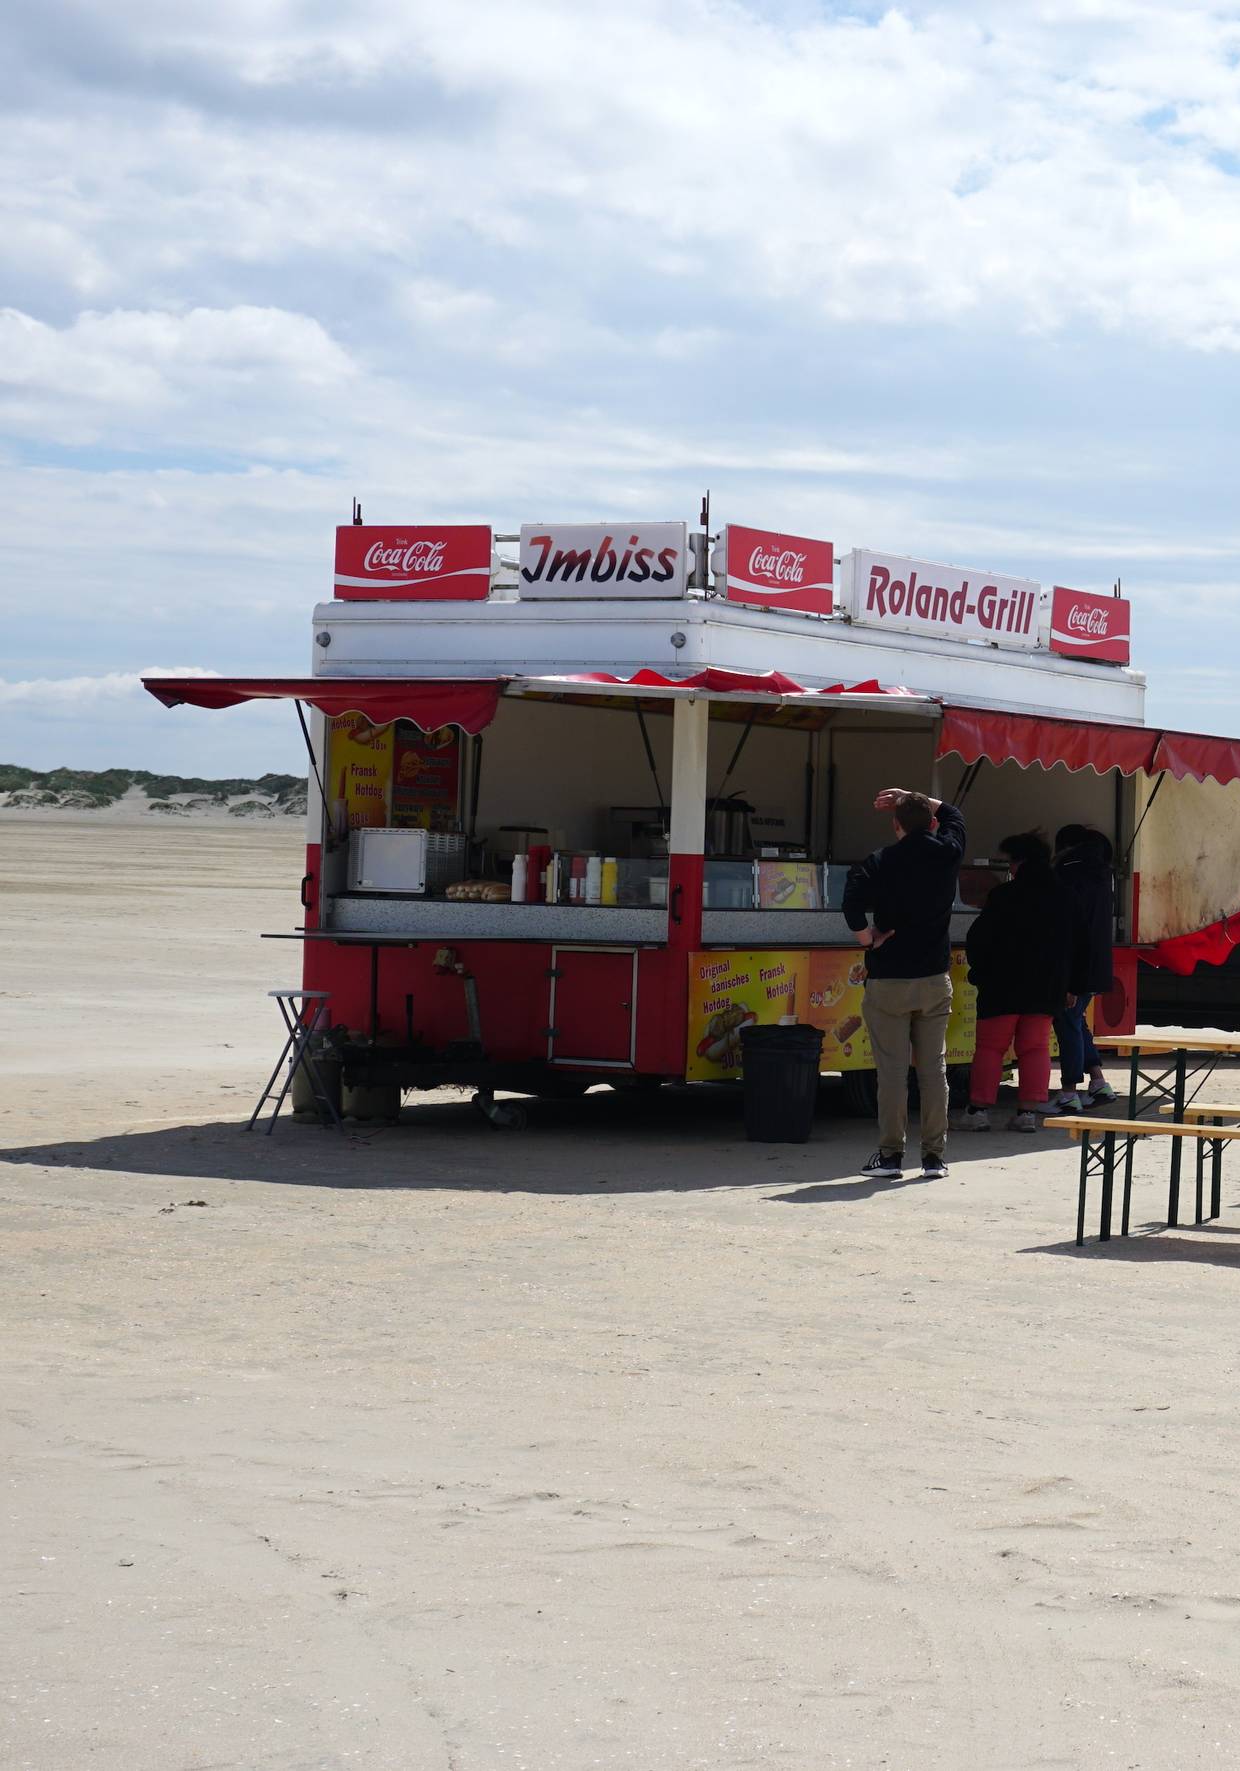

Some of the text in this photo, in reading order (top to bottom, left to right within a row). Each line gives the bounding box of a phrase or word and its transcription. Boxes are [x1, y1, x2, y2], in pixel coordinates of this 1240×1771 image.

[866, 565, 1035, 635] Roland-Grill
[351, 763, 377, 777] Fransk
[355, 783, 384, 799] Hotdog
[700, 960, 730, 979] Original
[759, 963, 785, 982] Fransk
[766, 981, 795, 999] Hotdog
[703, 998, 731, 1013] Hotdog
